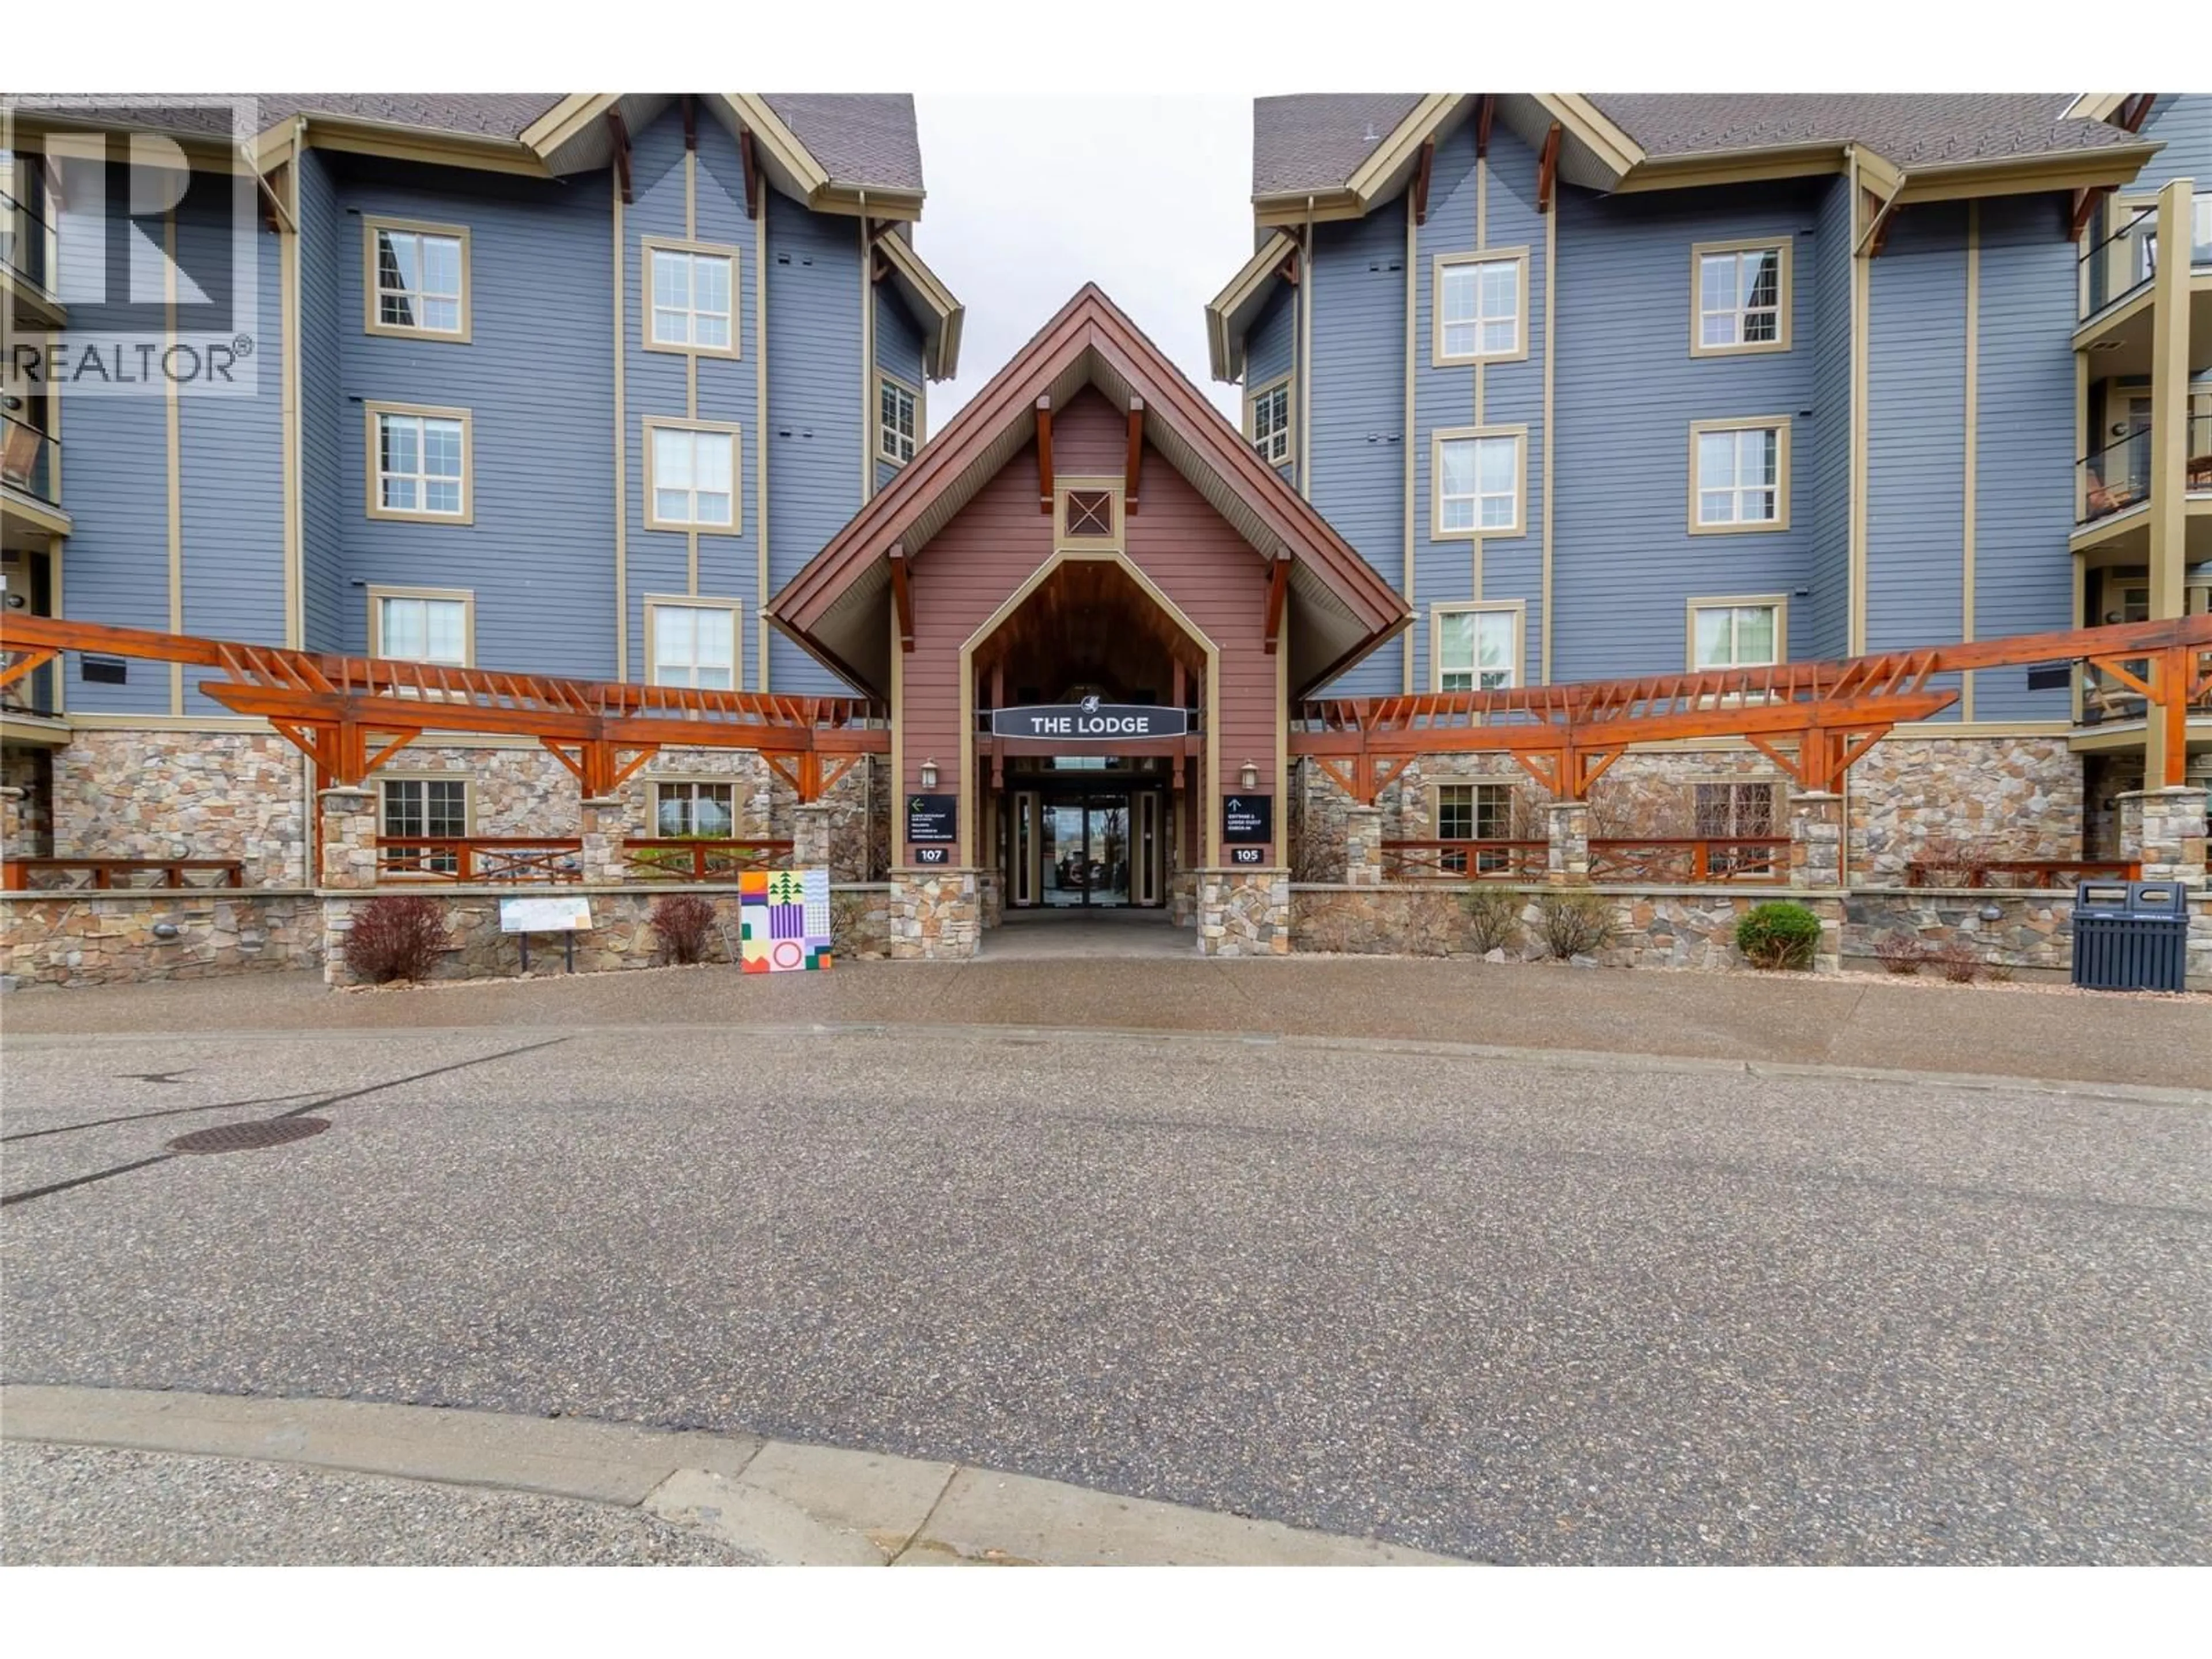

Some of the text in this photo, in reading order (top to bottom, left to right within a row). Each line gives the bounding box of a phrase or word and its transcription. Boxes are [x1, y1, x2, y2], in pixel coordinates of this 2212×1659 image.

[1031, 717, 1149, 733] THE LODGE
[921, 850, 942, 860] 107
[1236, 850, 1258, 860] 105
